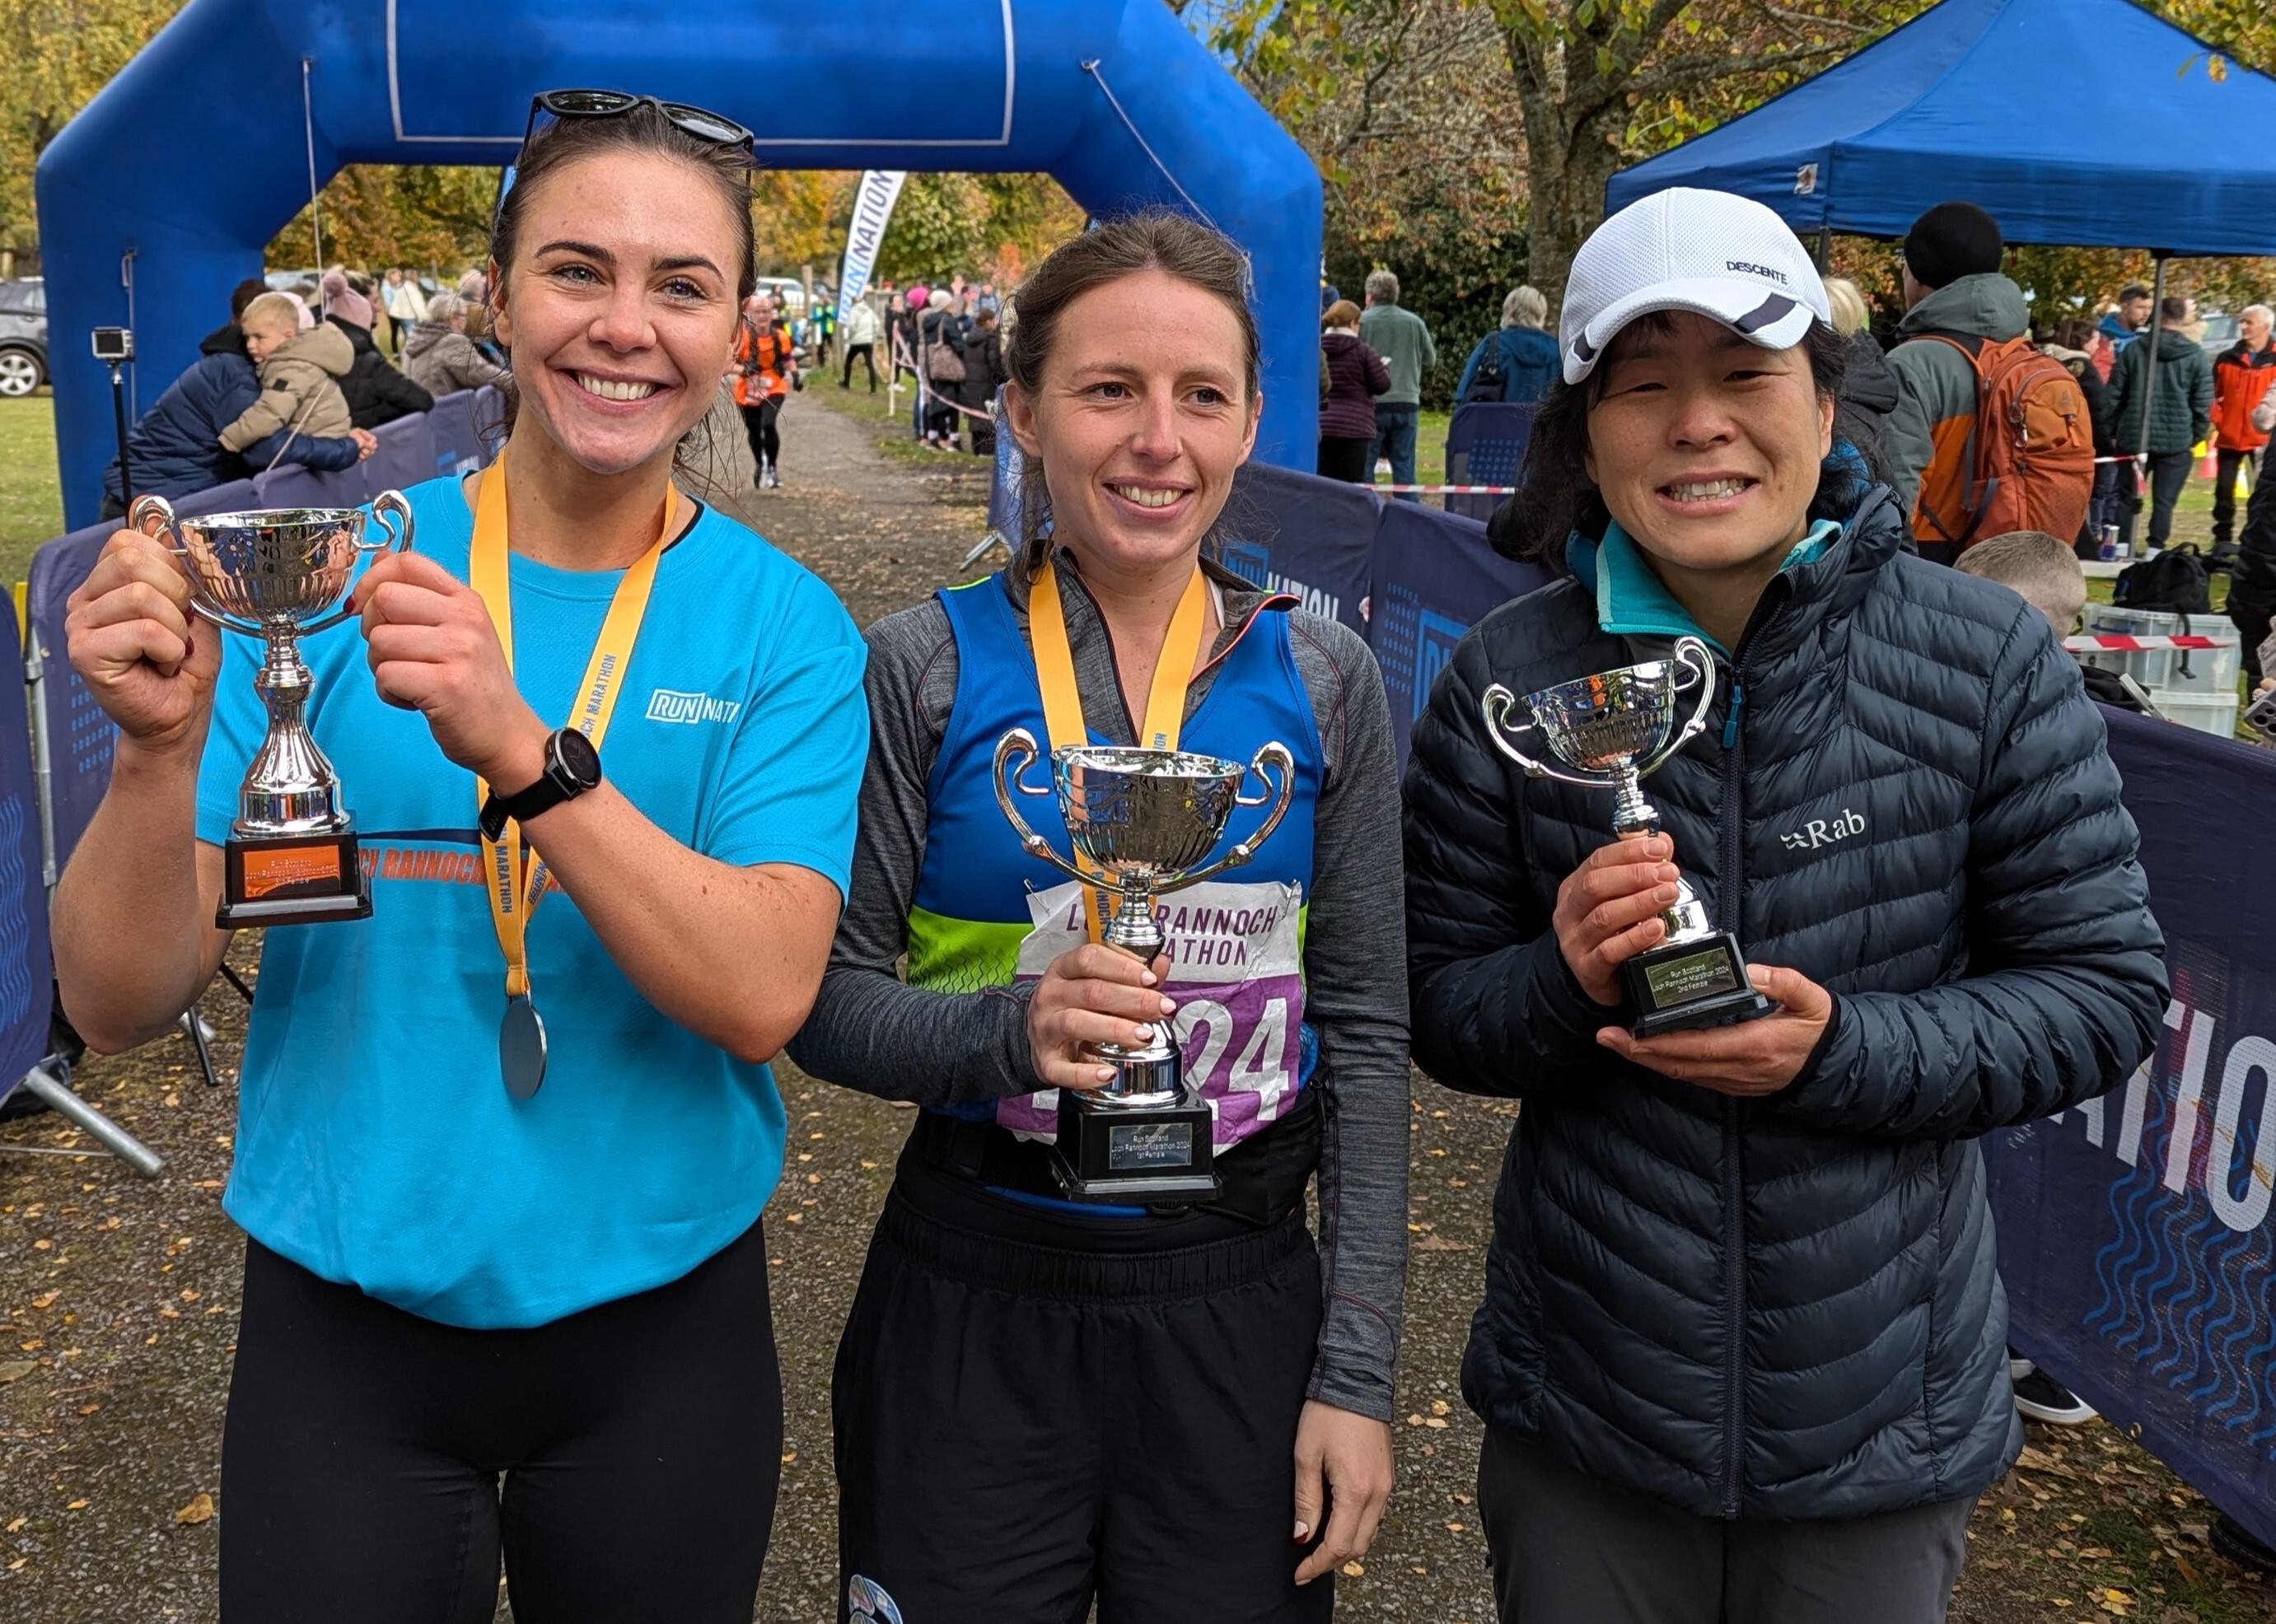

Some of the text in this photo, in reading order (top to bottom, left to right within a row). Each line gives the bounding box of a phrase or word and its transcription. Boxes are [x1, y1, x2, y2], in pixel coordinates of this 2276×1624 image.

[1727, 261, 1788, 285] DESCENTE
[587, 655, 617, 716] MARATHON
[654, 694, 699, 720] RUN
[1804, 808, 1865, 849] Rab
[495, 846, 512, 913] MARATHON
[1155, 905, 1278, 936] RANNOCH
